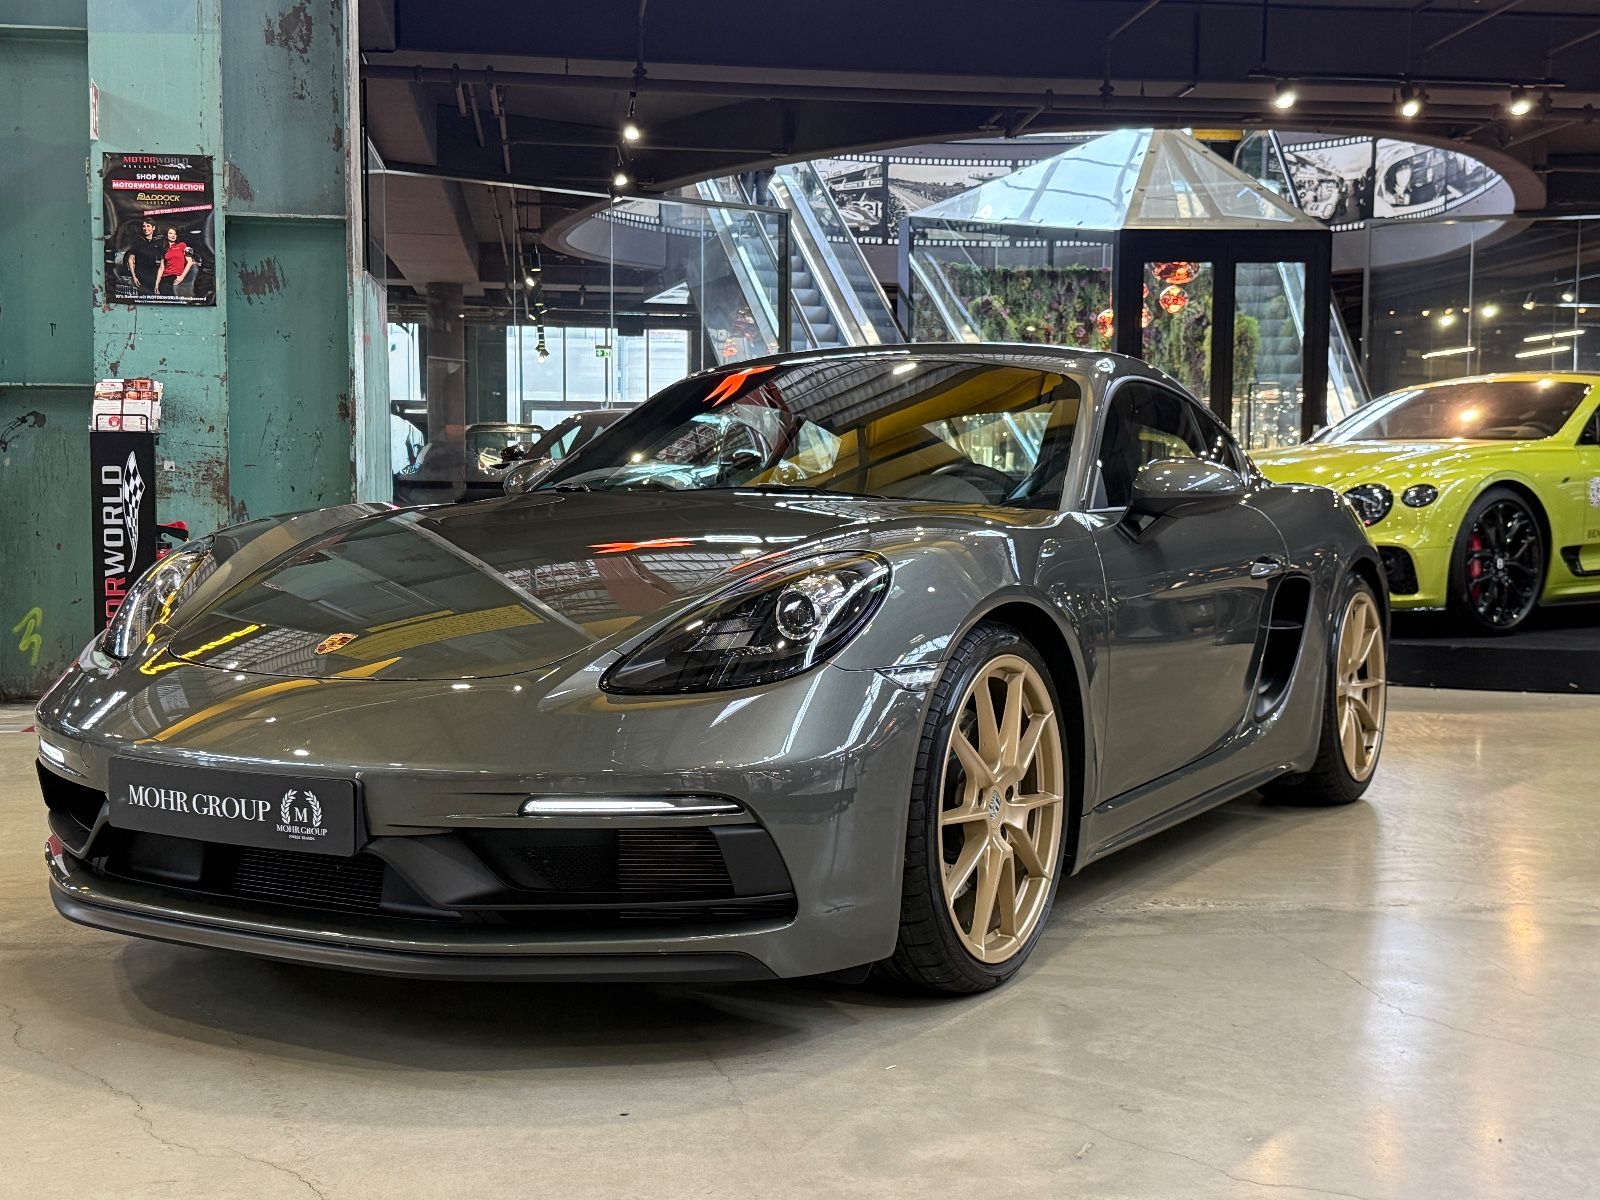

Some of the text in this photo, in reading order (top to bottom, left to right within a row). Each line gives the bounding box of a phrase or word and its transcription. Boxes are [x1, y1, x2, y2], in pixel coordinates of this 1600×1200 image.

[123, 156, 189, 164] MOTORWORLD
[112, 182, 205, 191] MOTORWORLD COLLECTION
[136, 192, 181, 201] PADDOCK
[101, 465, 126, 628] ORWORLD
[128, 784, 271, 822] MOHR GROUP
[294, 806, 309, 823] M
[276, 824, 328, 836] MOHR GROUP
